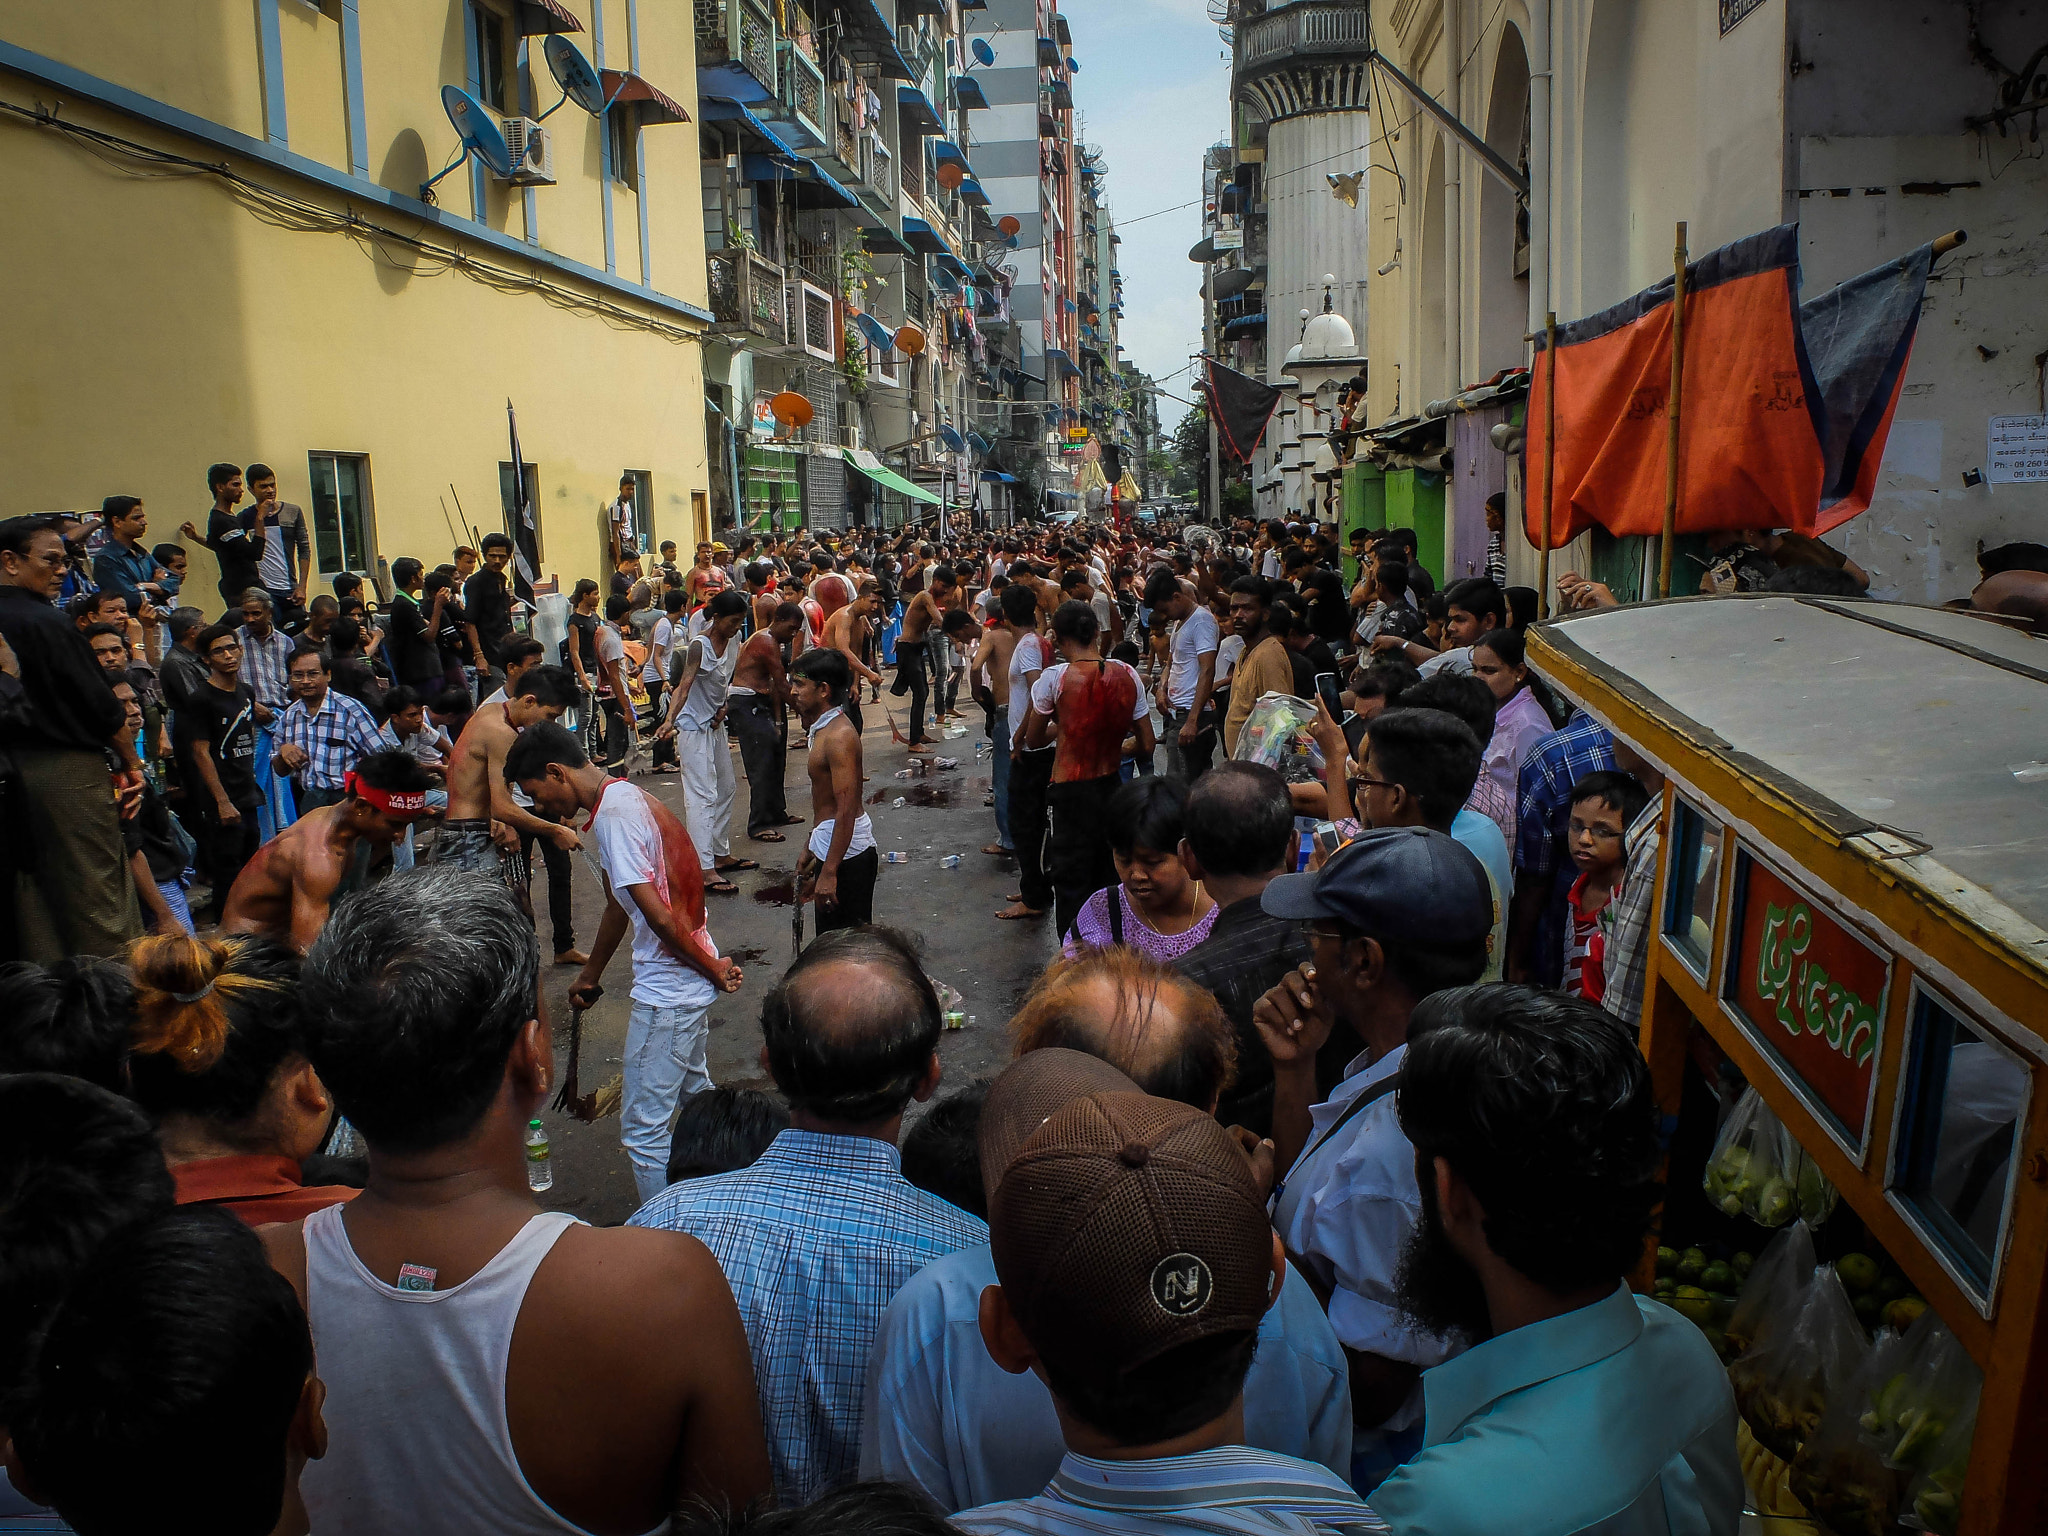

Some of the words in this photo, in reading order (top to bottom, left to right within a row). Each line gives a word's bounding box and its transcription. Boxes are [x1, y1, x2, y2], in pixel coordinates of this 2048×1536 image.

[2014, 460, 2025, 468] 09
[2026, 460, 2042, 468] 260
[2013, 470, 2024, 478] 09
[389, 794, 404, 802] YA
[1164, 1265, 1199, 1301] N
